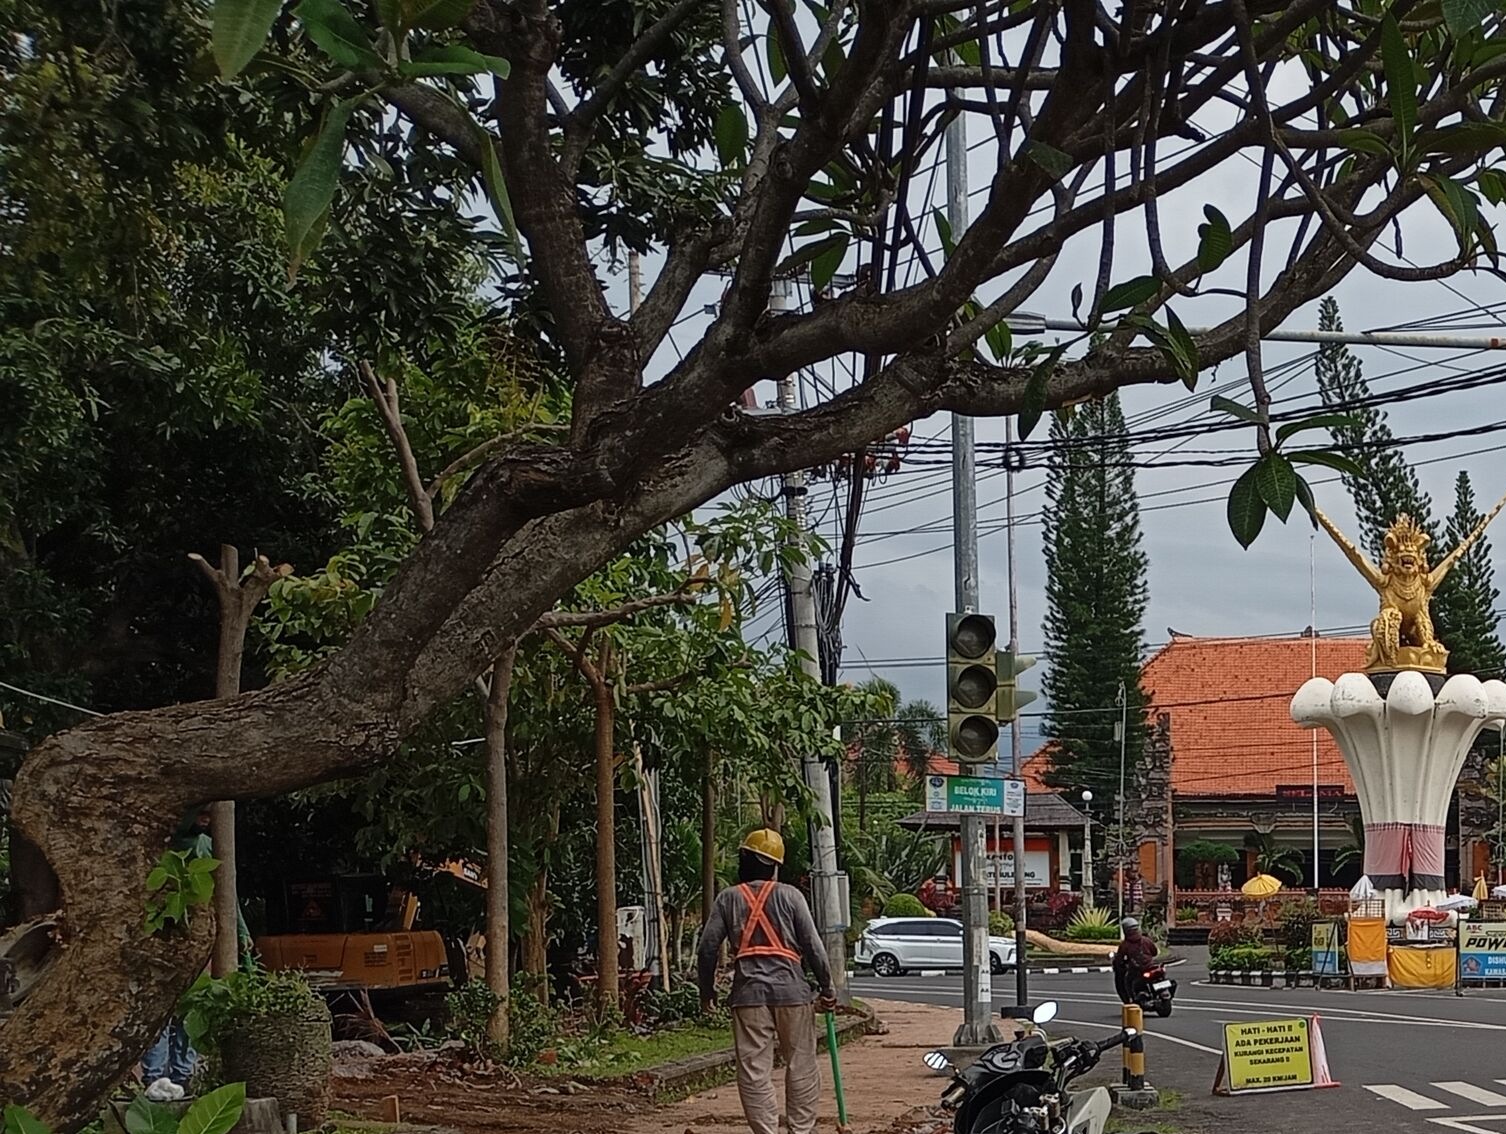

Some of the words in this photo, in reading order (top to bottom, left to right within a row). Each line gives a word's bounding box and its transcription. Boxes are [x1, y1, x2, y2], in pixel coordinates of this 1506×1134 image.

[954, 786, 979, 796] BELOK
[980, 787, 997, 797] KIRI
[950, 804, 976, 812] JALAN
[1241, 1027, 1260, 1035] HATI
[1267, 1025, 1285, 1033] HATI
[1235, 1039, 1252, 1047] ADA
[1254, 1035, 1300, 1045] PEKERJAAN
[1265, 1046, 1303, 1055] KECEPATAN
[1249, 1057, 1284, 1065] SEKARANG
